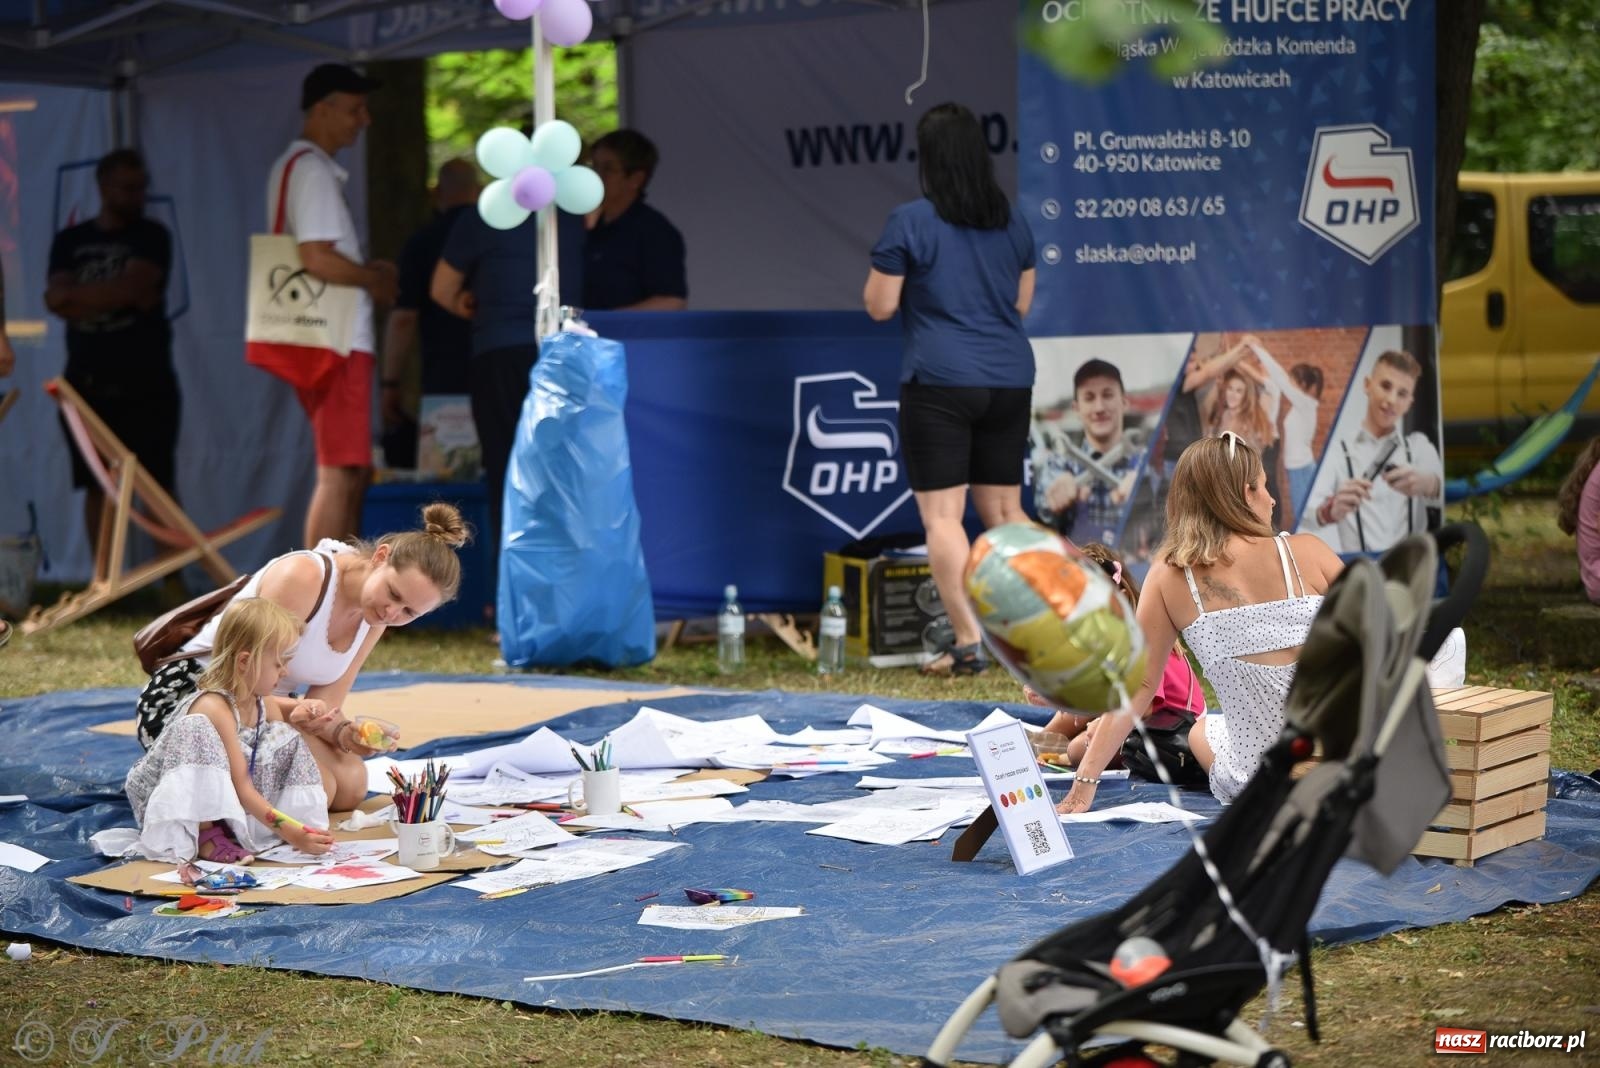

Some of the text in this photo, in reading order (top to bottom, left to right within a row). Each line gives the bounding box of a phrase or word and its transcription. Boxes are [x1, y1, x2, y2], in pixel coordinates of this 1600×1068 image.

[1231, 0, 1321, 23] HUFCE
[1326, 0, 1411, 21] PRACY
[1106, 38, 1157, 61] ląska
[1277, 35, 1356, 56] Komenda
[1172, 68, 1292, 89] w Katowicach
[1073, 127, 1251, 151] Pl. Grunwaldzki 8-10
[1073, 153, 1222, 173] 40-950 Katowice
[1074, 198, 1098, 218] 32
[1101, 198, 1137, 218] 209
[1139, 197, 1162, 217] 08
[1165, 196, 1188, 217] 63
[1202, 195, 1225, 216] 65
[1325, 198, 1400, 225] OHP
[1075, 241, 1197, 265] slaska@ohp.pl
[809, 460, 898, 496] OHP
